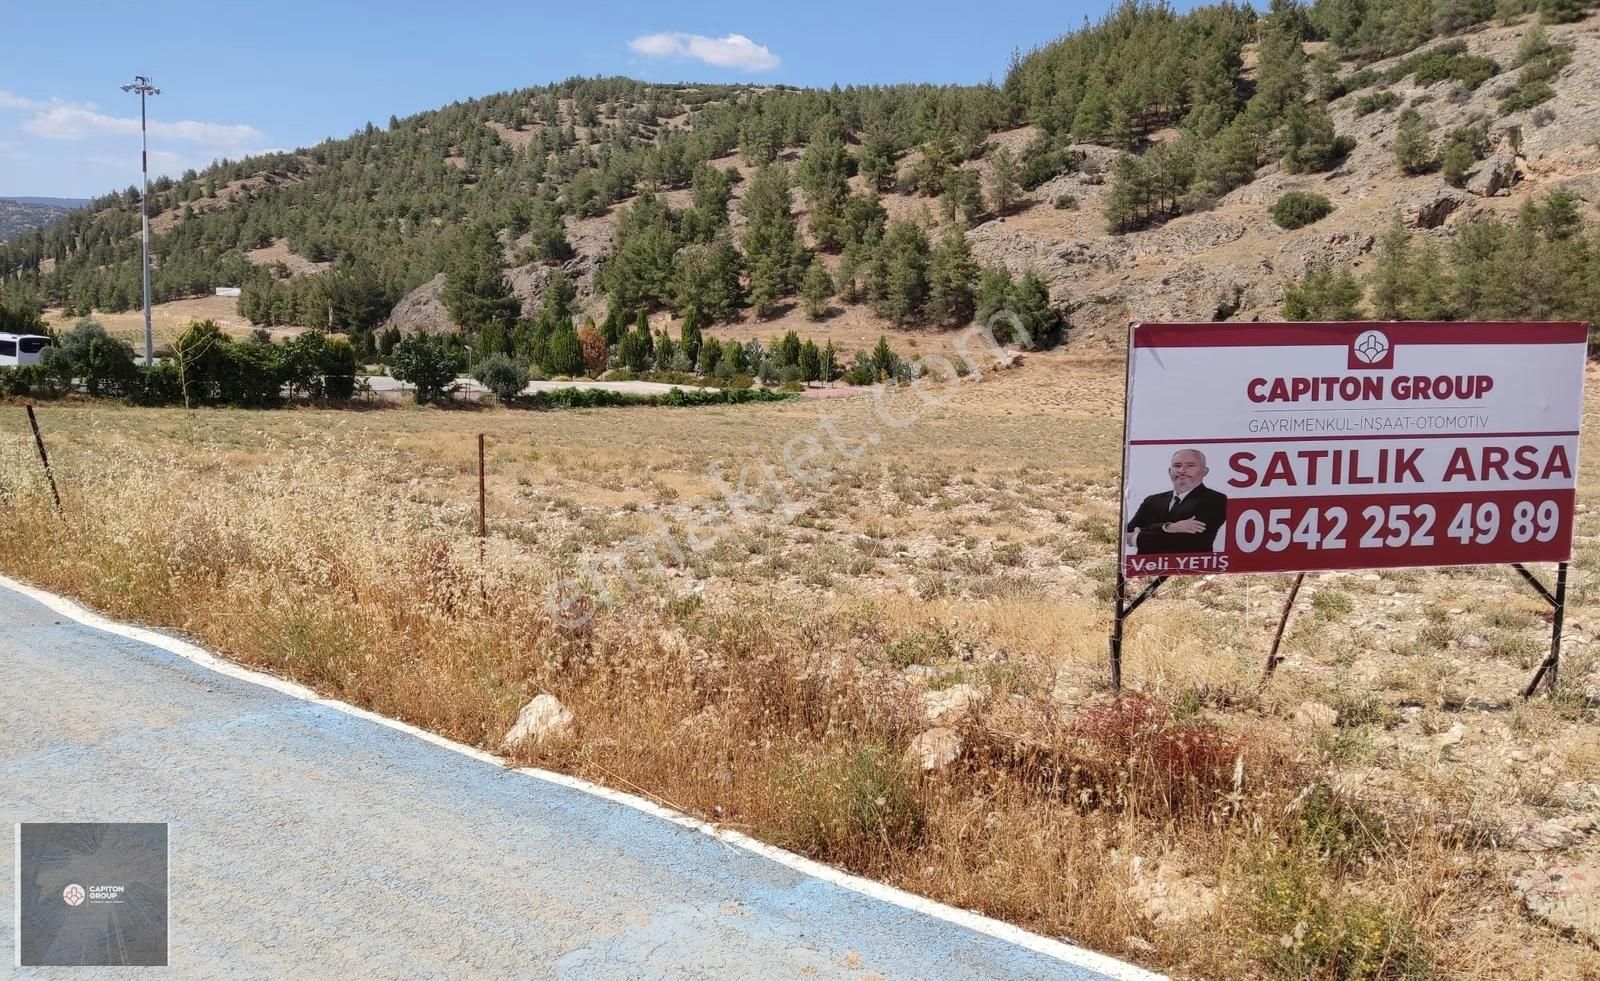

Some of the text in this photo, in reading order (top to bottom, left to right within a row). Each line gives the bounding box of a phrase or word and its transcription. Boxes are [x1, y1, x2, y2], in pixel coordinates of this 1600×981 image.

[1247, 375, 1494, 403] CAPITON GROUP
[1248, 415, 1489, 433] GAYRİMENKUL-İNŞAAT-OTOMOTİV
[1227, 444, 1572, 488] SATILIK ARSA
[1235, 500, 1560, 553] 0542 252 49 89
[1131, 554, 1229, 572] Veli YETİŞ
